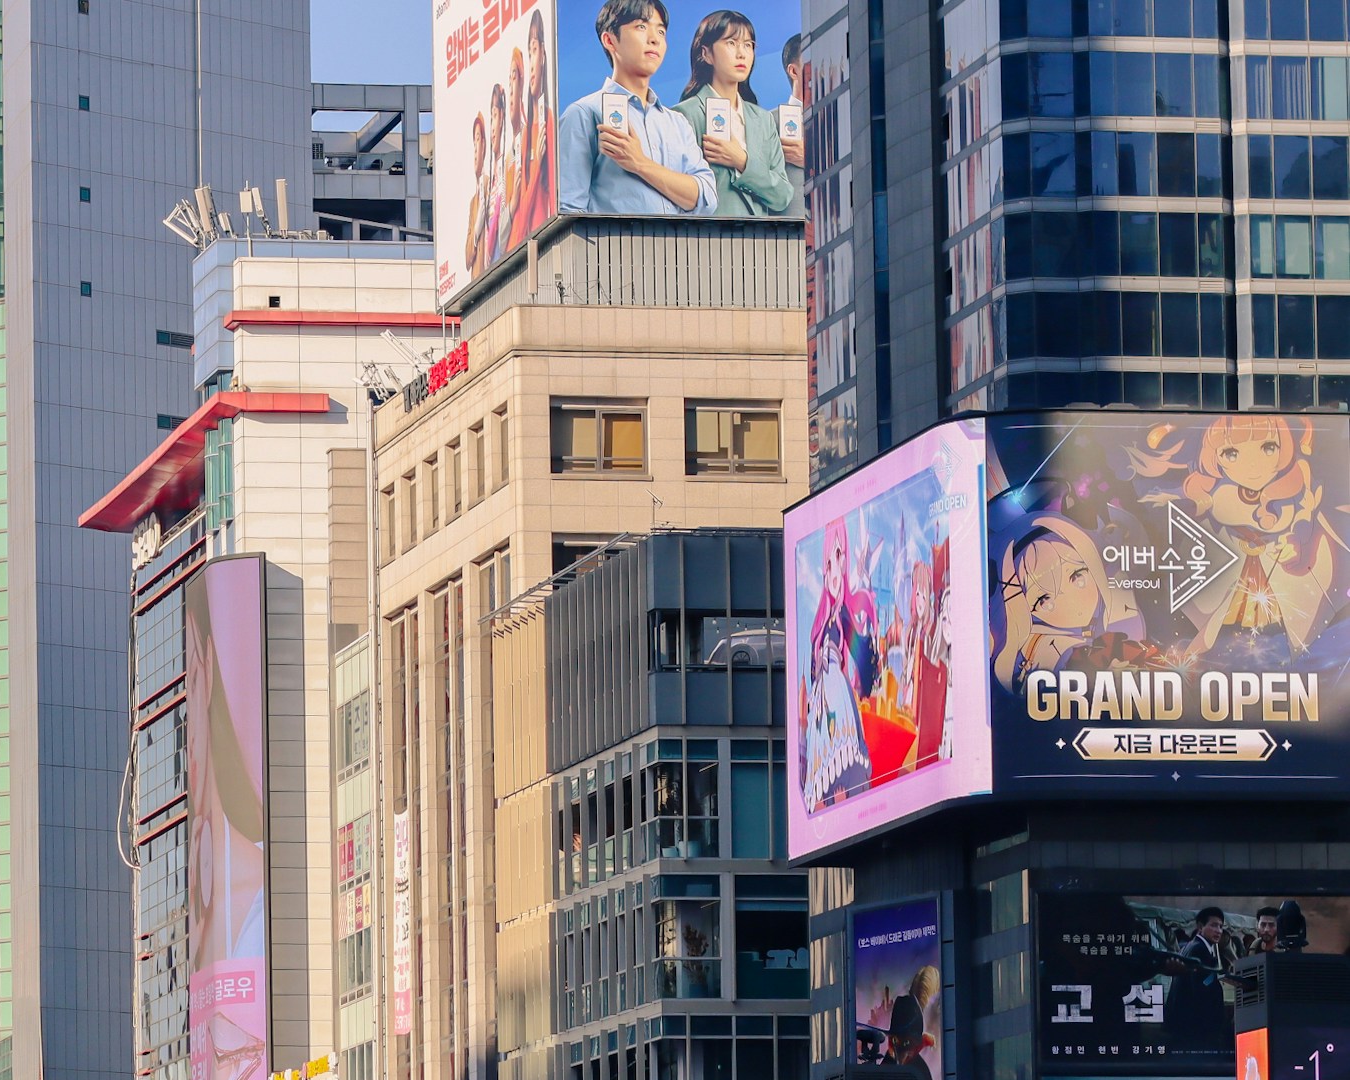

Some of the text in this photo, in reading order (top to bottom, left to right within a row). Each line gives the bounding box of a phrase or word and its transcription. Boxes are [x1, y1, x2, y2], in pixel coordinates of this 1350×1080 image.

[447, 16, 479, 88] 알바는
[945, 494, 967, 513] OPEN
[1102, 533, 1212, 573] 에버소울
[1108, 576, 1161, 592] Eversoul
[1026, 671, 1320, 723] GRAND OPEN
[1113, 731, 1239, 756] 지금 다운로드
[1097, 934, 1125, 943] 구하기
[215, 976, 253, 1001] 글로우
